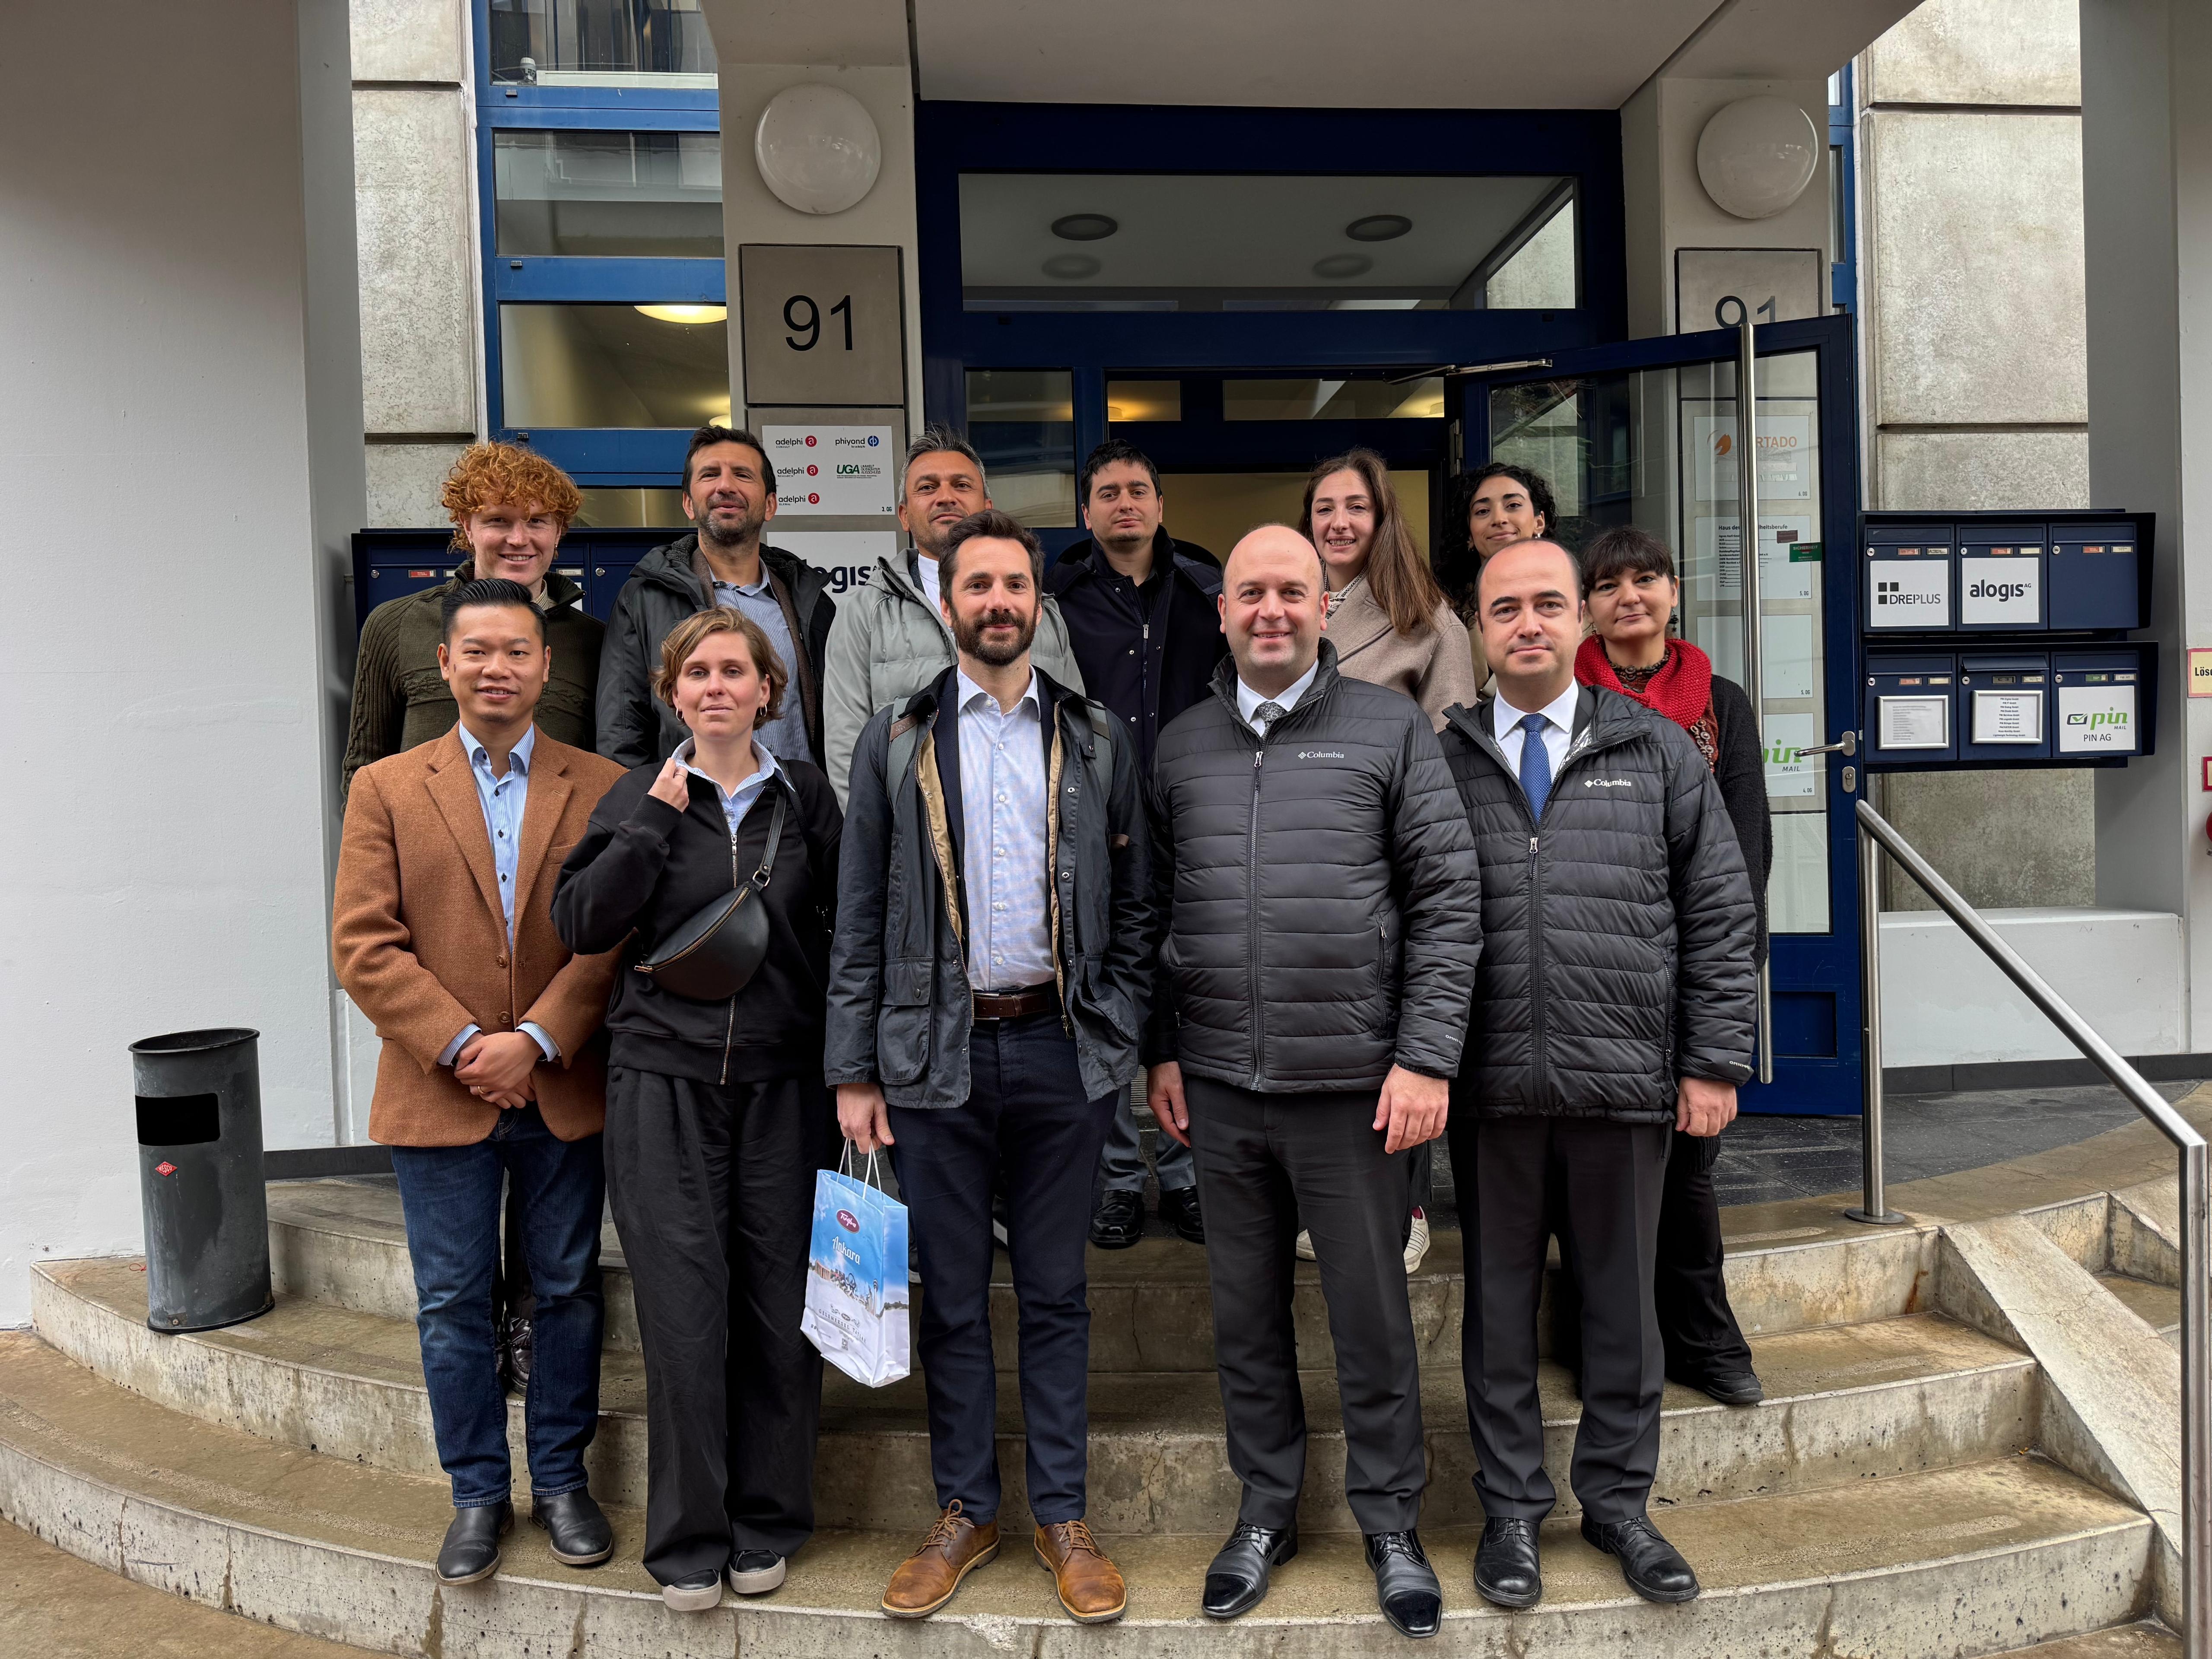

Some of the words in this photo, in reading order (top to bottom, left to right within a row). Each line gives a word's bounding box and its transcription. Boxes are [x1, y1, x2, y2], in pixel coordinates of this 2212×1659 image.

[784, 292, 852, 351] 91
[775, 438, 803, 446] adelphi
[835, 437, 865, 446] phiyond
[1755, 436, 1797, 448] RTADO
[777, 467, 804, 475] adelphi
[836, 464, 860, 474] UGA
[779, 495, 806, 503] adelphi
[813, 566, 871, 594] gis
[1970, 579, 2024, 602] alogis
[1889, 594, 1941, 604] DREPLUS
[2090, 707, 2128, 730] pin
[2100, 733, 2111, 741] AG
[1593, 779, 1631, 787] Columbia
[159, 1164, 172, 1173] WESCO
[832, 1236, 860, 1265] Ankara
